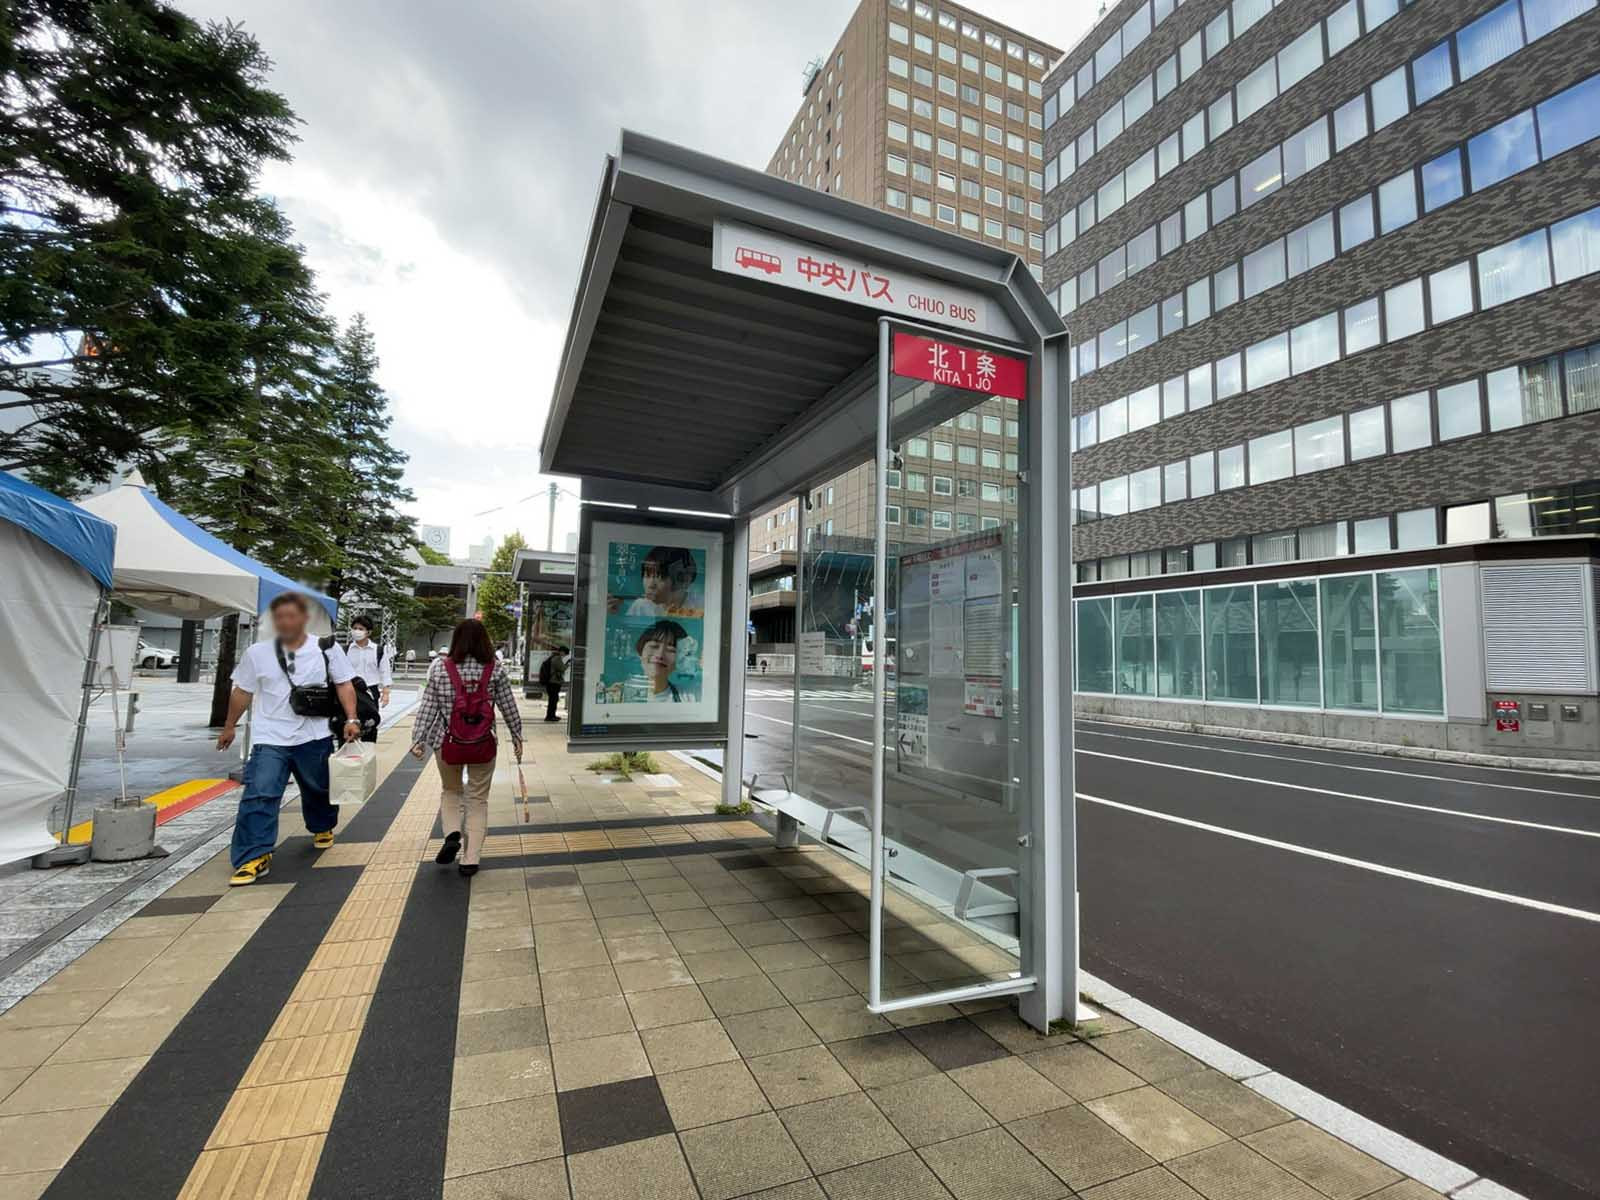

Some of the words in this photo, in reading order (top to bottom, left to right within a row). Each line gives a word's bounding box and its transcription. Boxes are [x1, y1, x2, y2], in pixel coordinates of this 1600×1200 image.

[797, 256, 894, 303] 中央バス
[908, 294, 945, 316] CHUO
[949, 304, 977, 323] BUS
[934, 367, 961, 385] KITA
